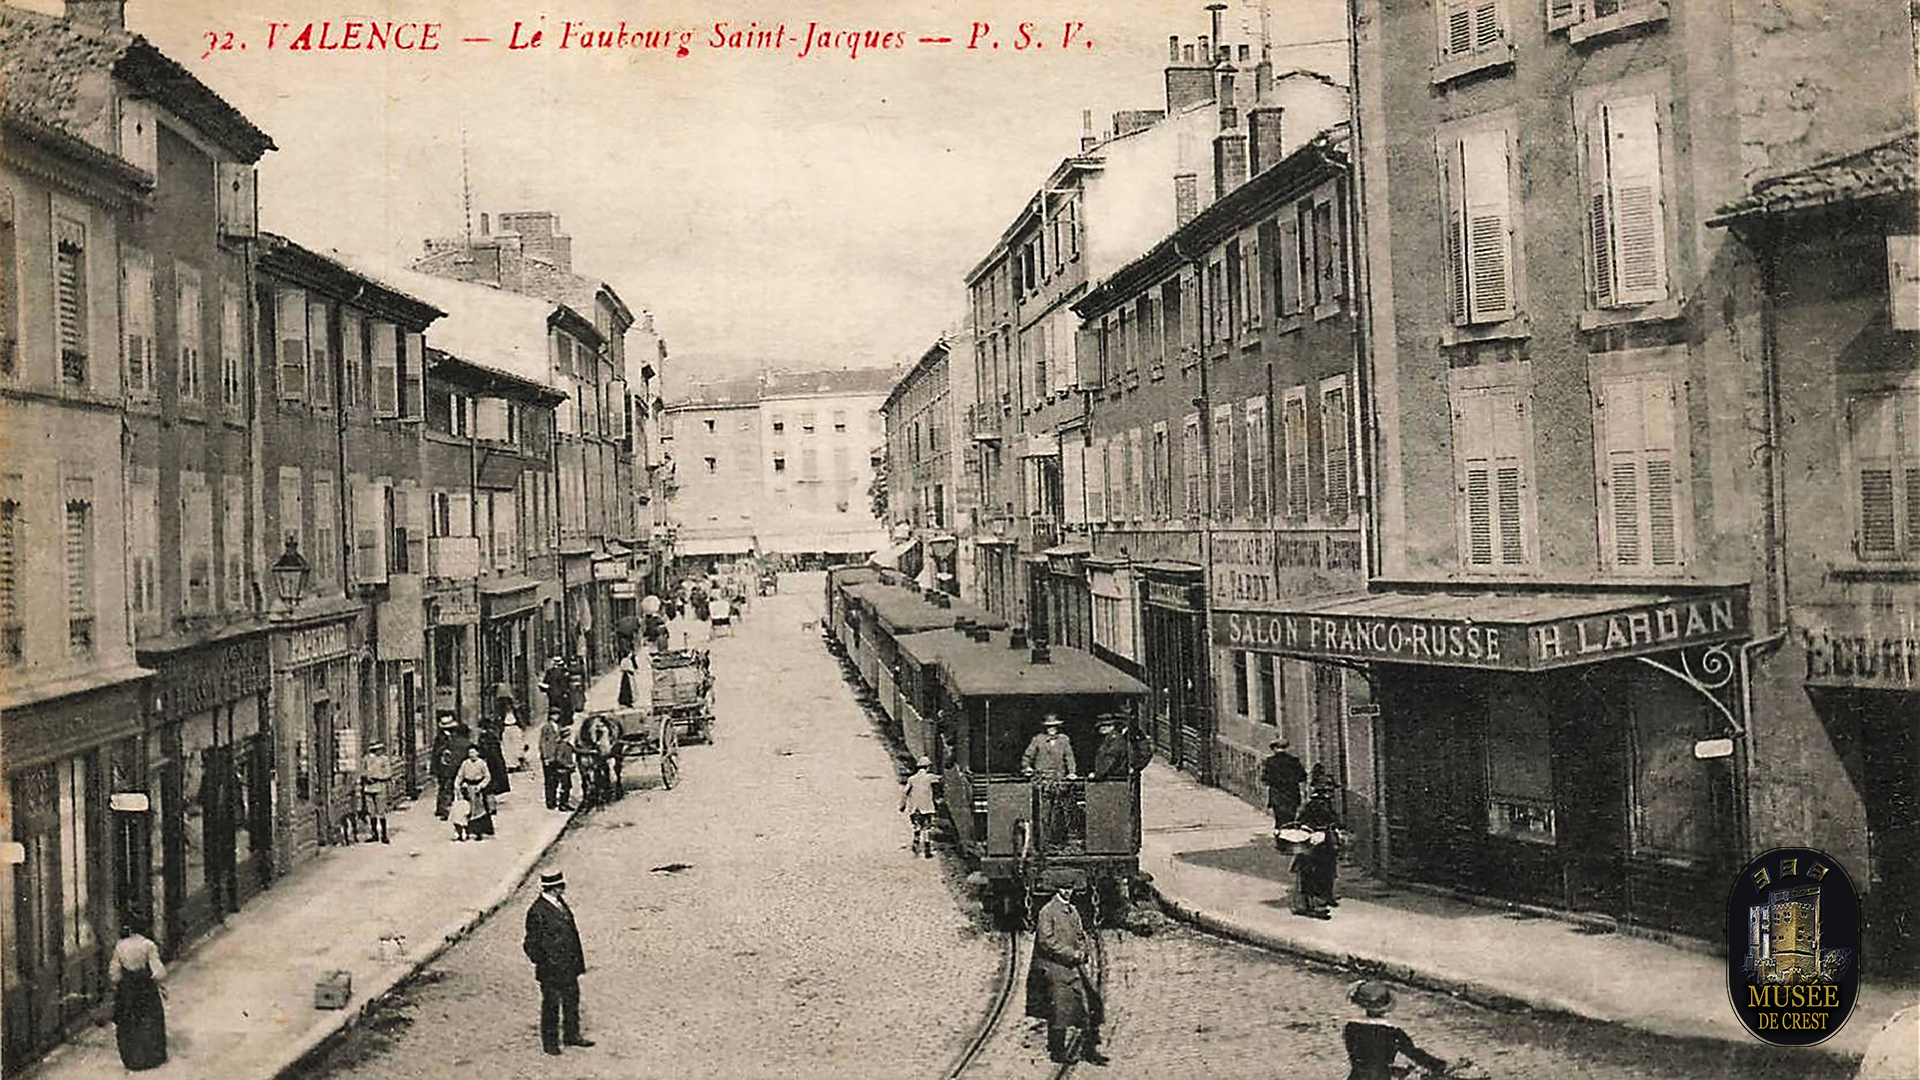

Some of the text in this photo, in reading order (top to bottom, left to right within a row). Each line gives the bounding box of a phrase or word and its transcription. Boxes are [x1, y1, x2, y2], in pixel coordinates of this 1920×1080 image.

[1229, 613, 1501, 661] SALON FRANCO-RUSSE
[1535, 599, 1735, 661] H. LARDAN
